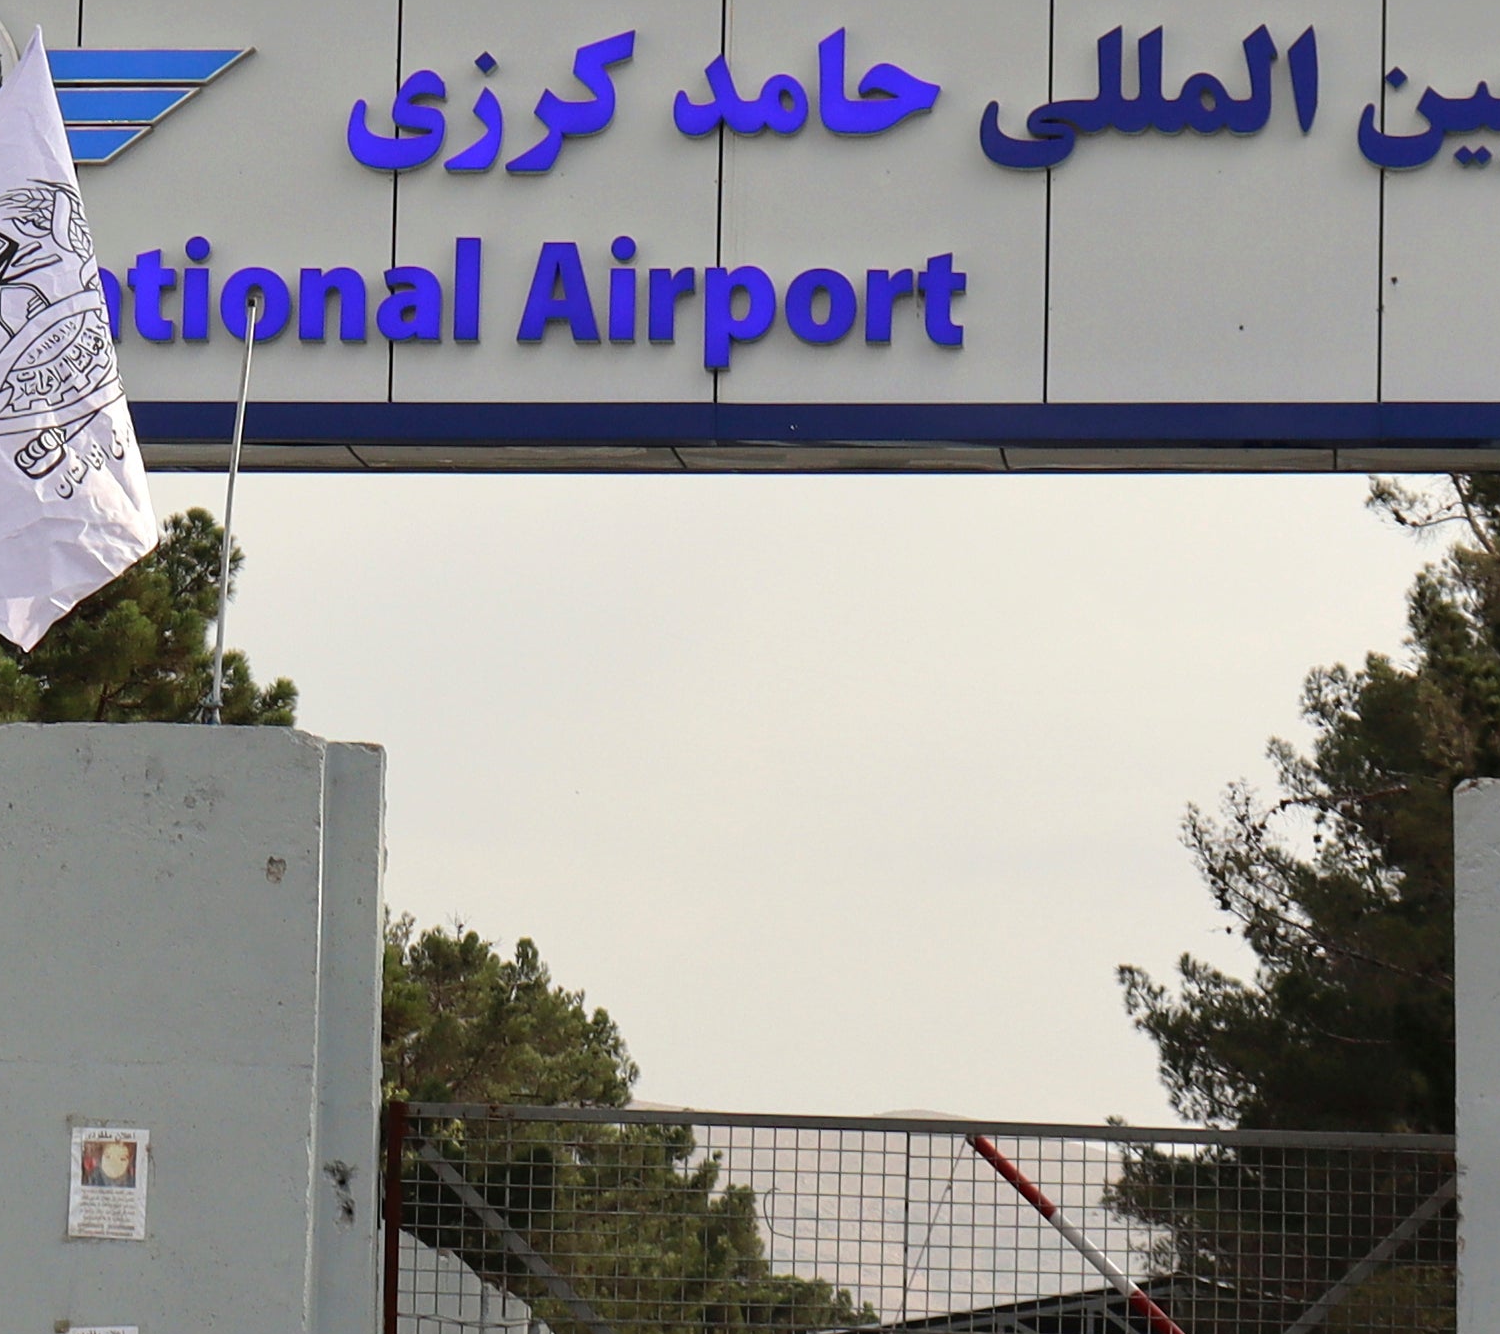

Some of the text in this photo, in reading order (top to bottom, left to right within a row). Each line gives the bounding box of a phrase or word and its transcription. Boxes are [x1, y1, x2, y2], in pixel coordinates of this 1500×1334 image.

[347, 30, 636, 173] کرزی
[673, 27, 941, 137] حامد
[980, 26, 1318, 170] المللی
[517, 235, 968, 364] Airport
